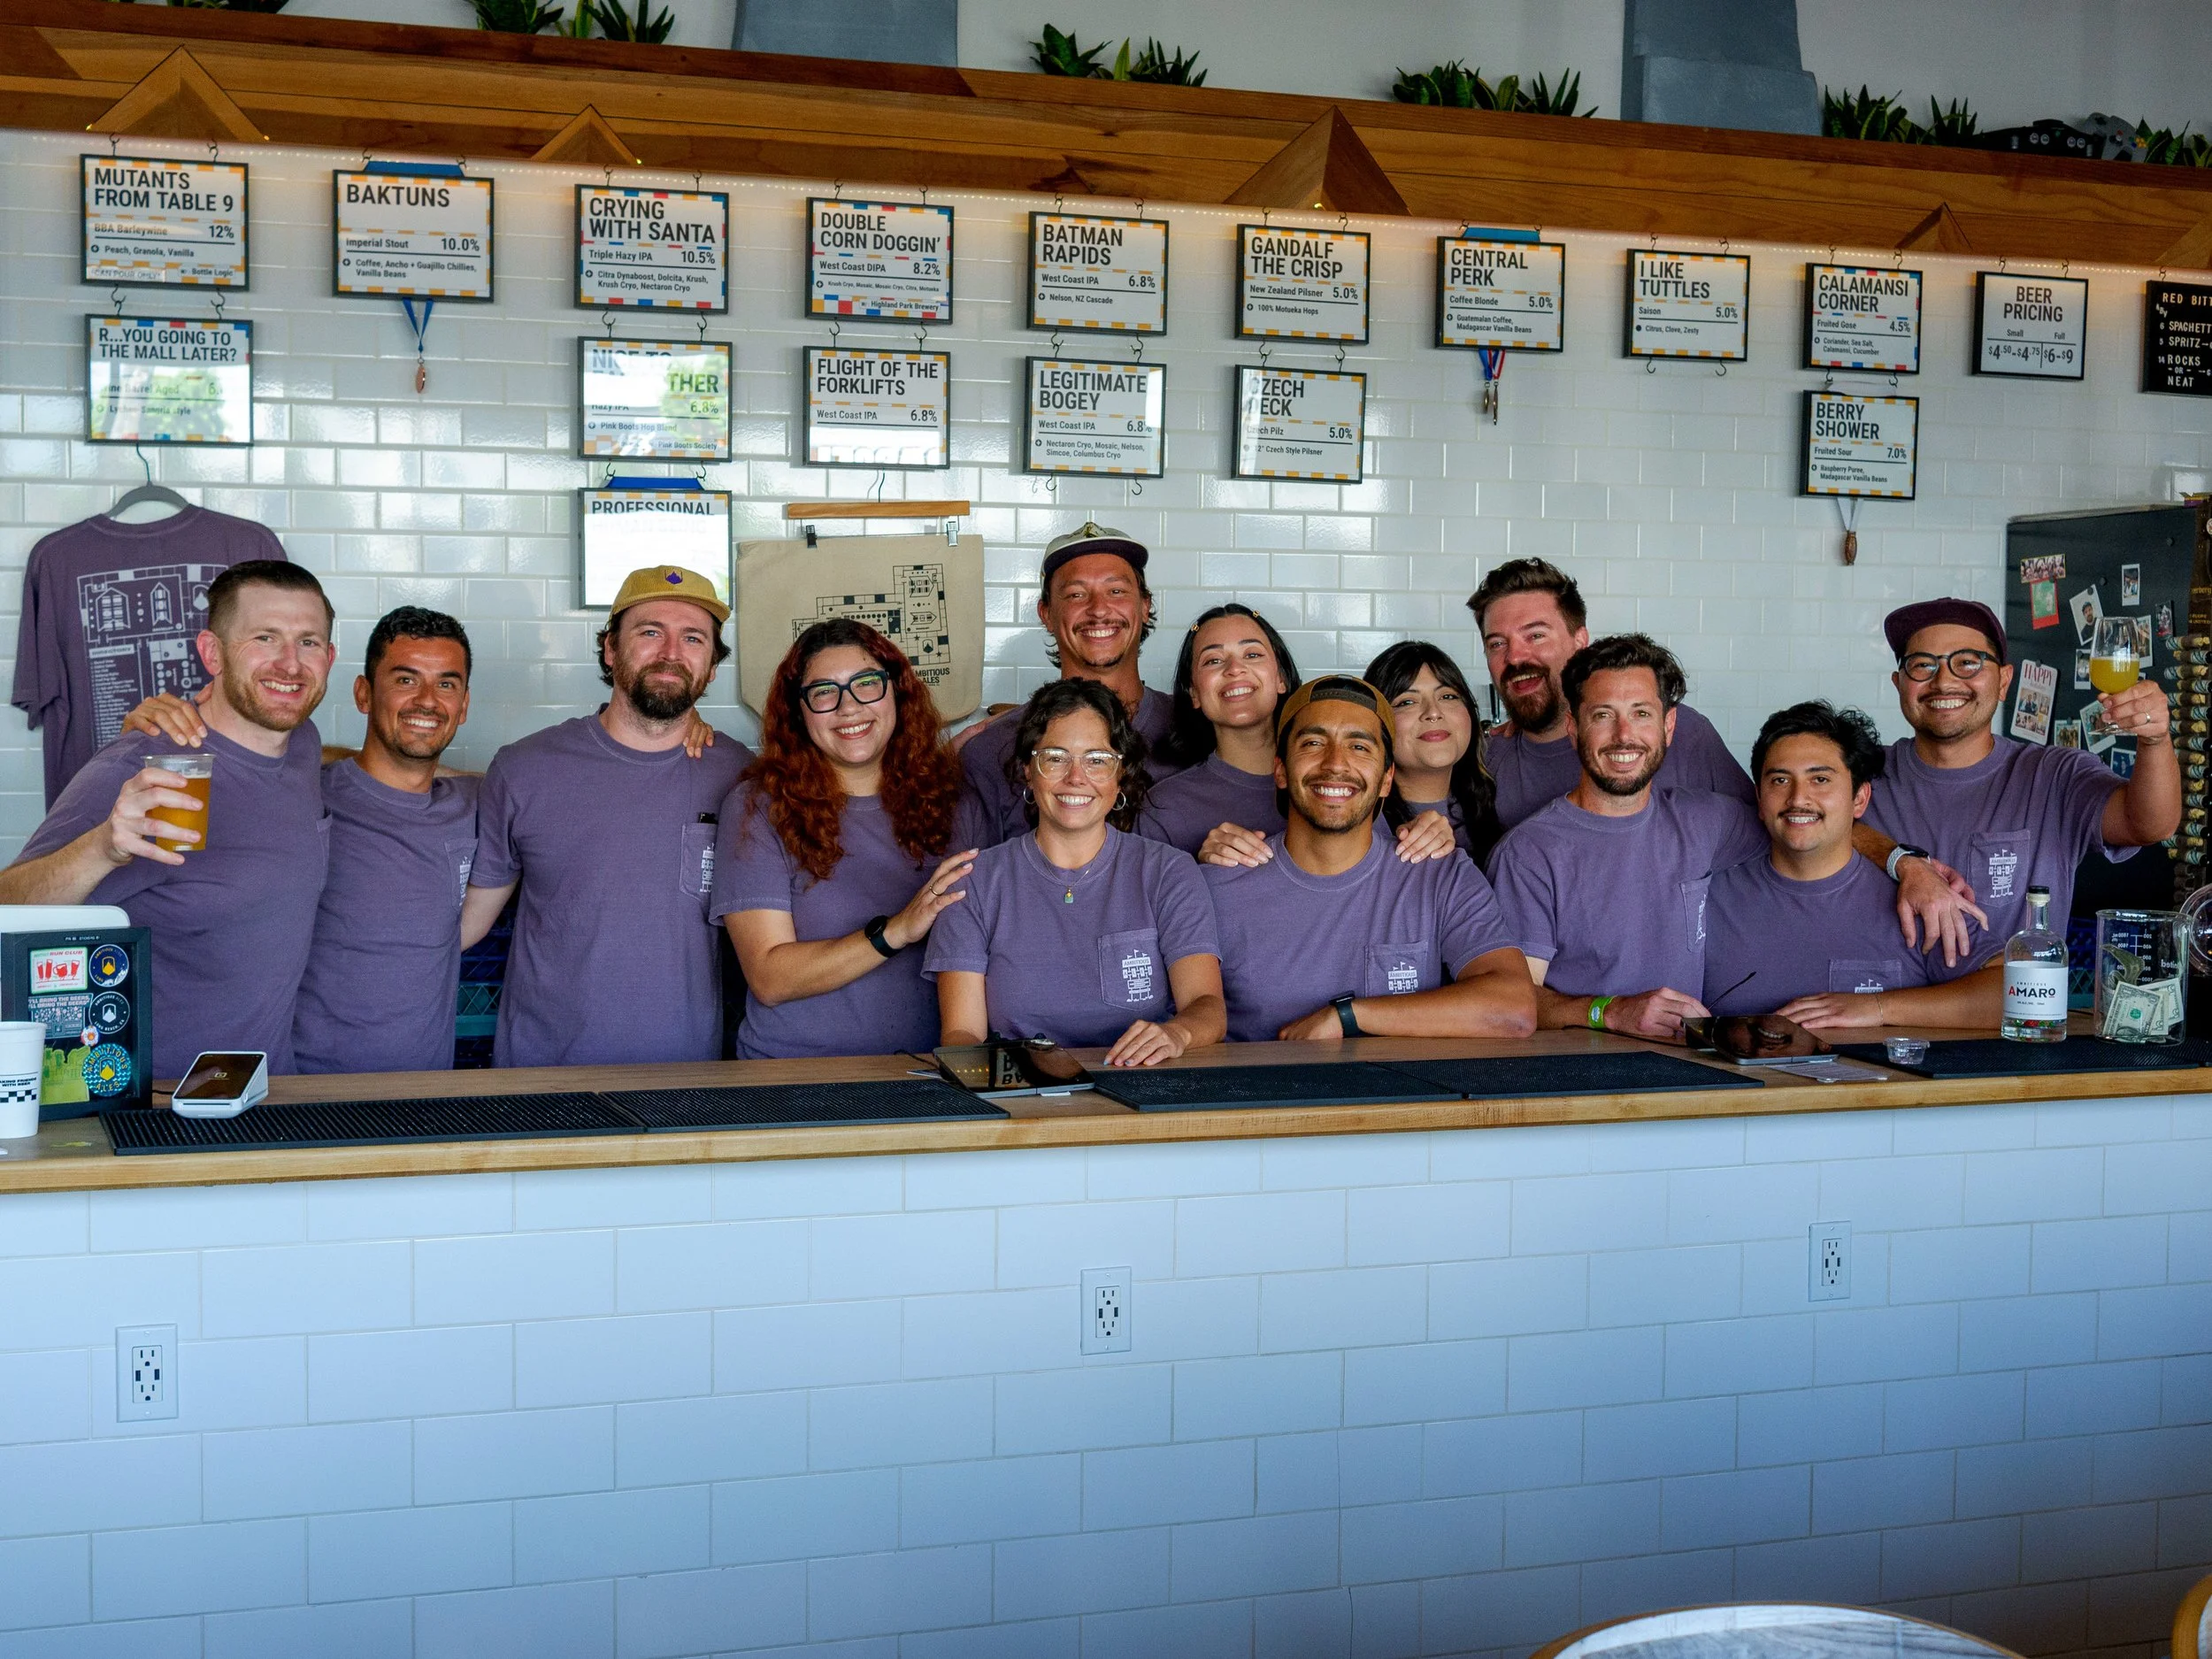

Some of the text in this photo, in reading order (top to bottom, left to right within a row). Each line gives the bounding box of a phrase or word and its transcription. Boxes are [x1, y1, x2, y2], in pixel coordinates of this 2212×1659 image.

[95, 168, 189, 189] MUTANTS
[95, 188, 233, 211] FROM TABLE 9
[347, 184, 449, 207] BAKTUNS
[590, 197, 664, 219] CRYING
[821, 212, 886, 231] DOUBLE
[117, 225, 167, 236] Barleywine
[209, 226, 234, 238] 12%
[589, 219, 715, 243] WITH SANTA
[1043, 225, 1123, 246] BATMAN
[346, 238, 408, 249] Imperial Stout
[442, 238, 480, 251] 10.0%
[820, 231, 867, 249] CORN
[134, 247, 194, 257] Granola, Vanilla
[1043, 244, 1111, 265] RAPIDS
[1251, 237, 1333, 258] GANDALF
[589, 250, 652, 262] Triple Hazy IPA
[681, 250, 715, 264] 10.5%
[1451, 249, 1528, 269] CENTRAL
[356, 259, 382, 268] Coffee,
[417, 261, 444, 272] Guajillo
[842, 263, 864, 272] Coast
[867, 264, 886, 273] DIPA
[913, 263, 940, 275] 8.2%
[1251, 257, 1343, 279] THE CRISP
[1640, 260, 1684, 279] I LIKE
[617, 273, 656, 281] Dynaboost,
[687, 275, 708, 284] Krush,
[1041, 273, 1060, 282] West
[1063, 275, 1084, 284] Coast
[1129, 275, 1155, 288] 6.8%
[1450, 267, 1494, 286] PERK
[620, 281, 639, 290] Cryo,
[1268, 286, 1296, 296] Zealand
[1298, 288, 1323, 297] Pilsner
[1640, 280, 1709, 298] TUTTLES
[1819, 274, 1909, 296] CALAMANSI
[1049, 294, 1073, 303] Nelson,
[1333, 287, 1357, 299] 5.0%
[2016, 286, 2052, 303] BEER
[2162, 293, 2183, 303] RED
[1529, 296, 1553, 308] 5.0%
[1818, 293, 1878, 312] CORNER
[2004, 303, 2062, 322] PRICING
[1817, 319, 1839, 328] Fruited
[1890, 321, 1910, 333] 4.5%
[99, 328, 230, 345] R...YOU GOING TO
[99, 344, 236, 361] THE MALL LATER?
[2168, 355, 2200, 366] ROCKS
[818, 358, 938, 378] FLIGHT OF THE
[818, 378, 904, 395] FORKLIFTS
[1040, 371, 1146, 393] LEGITIMATE
[2168, 376, 2194, 387] NEAT
[691, 402, 718, 413] 6.8%
[1040, 391, 1100, 411] BOGEY
[910, 410, 937, 422] 6.8%
[1816, 403, 1864, 420] BERRY
[1329, 427, 1352, 439] 5.0%
[1816, 420, 1879, 440] SHOWER
[1077, 441, 1094, 449] Cryo,
[1887, 448, 1907, 458] 7.0%
[592, 501, 715, 515] PROFESSIONAL
[916, 668, 949, 677] MBITIOUS
[2024, 664, 2052, 686] HAPPY
[2008, 986, 2055, 998] AMARO
[87, 1048, 127, 1072] AMBITIOUS
[96, 1081, 119, 1091] ALES
